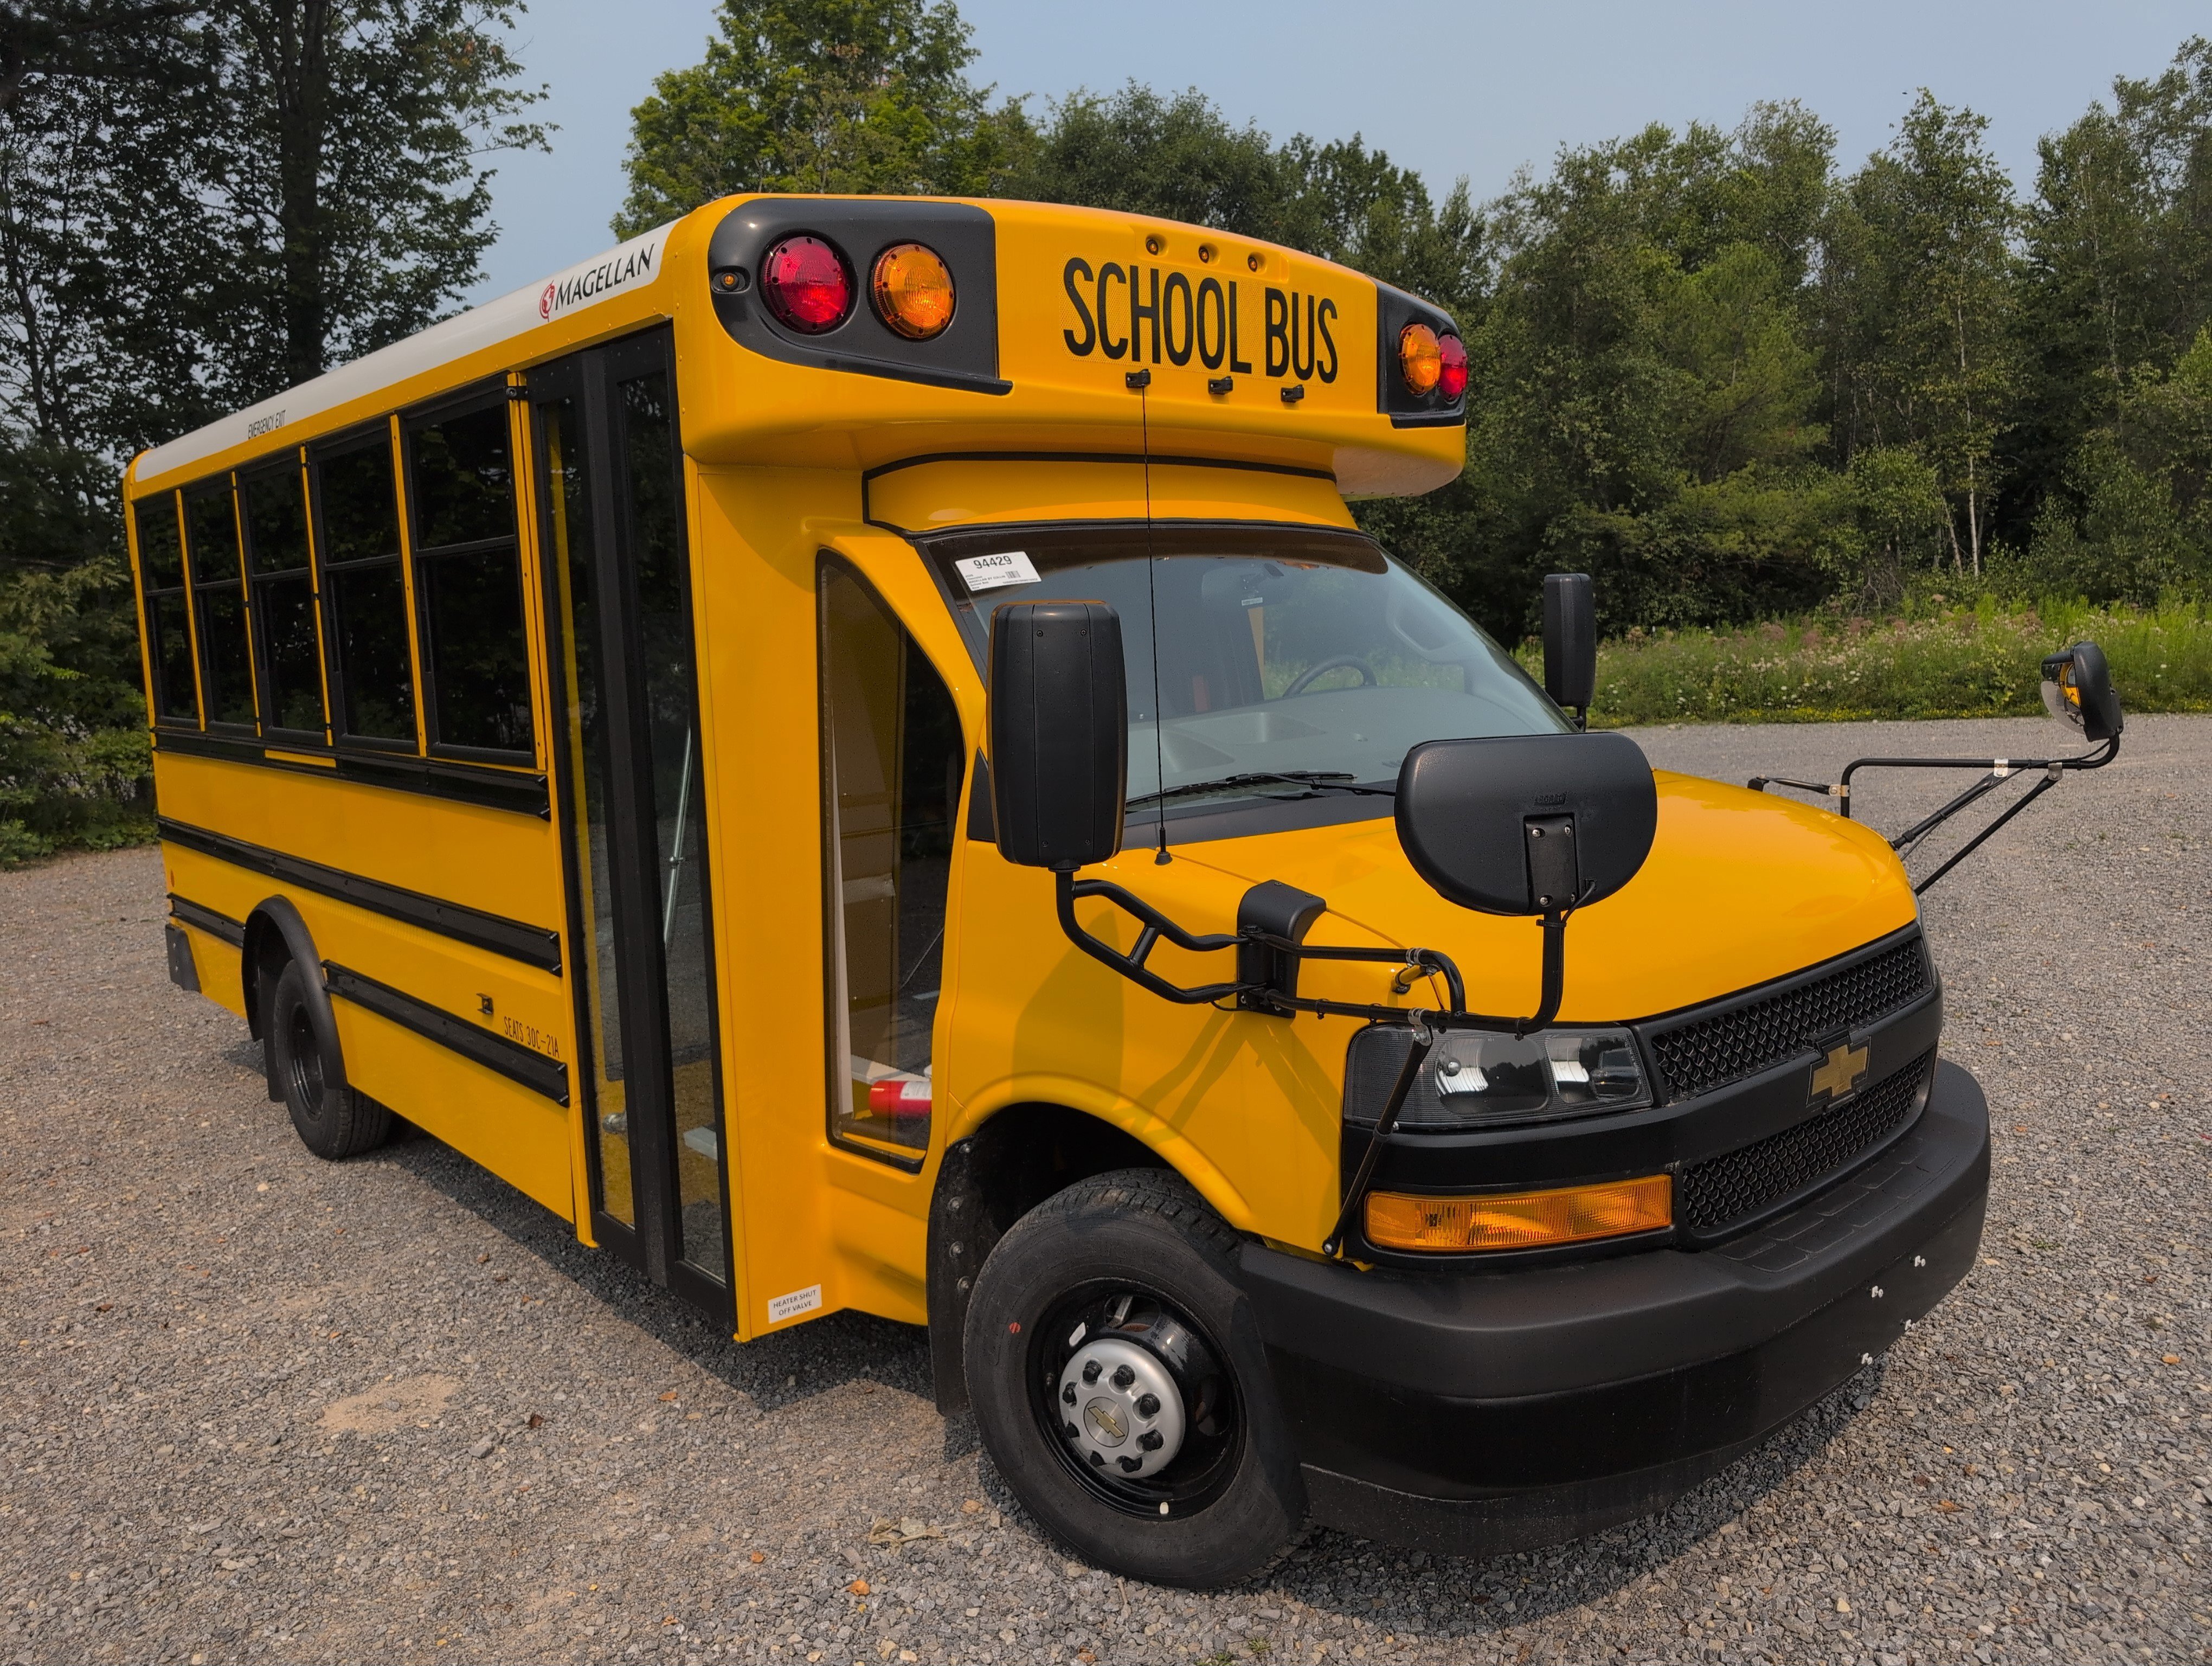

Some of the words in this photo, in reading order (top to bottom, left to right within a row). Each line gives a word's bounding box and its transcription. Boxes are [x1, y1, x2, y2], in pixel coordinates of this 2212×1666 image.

[555, 242, 655, 311] MAGELLAN
[1063, 257, 1252, 374] SCHOOL
[1265, 286, 1338, 384] BUS
[248, 414, 275, 440] EMERGENCY
[275, 409, 286, 428] EXIT
[973, 555, 1013, 569] 94429
[504, 1016, 524, 1043] SEATS
[526, 1026, 560, 1059] 30C-21A
[773, 1296, 798, 1309] HEATER
[799, 1289, 817, 1300] SHUT
[779, 1306, 792, 1316] OFF
[792, 1300, 813, 1311] VALVE
